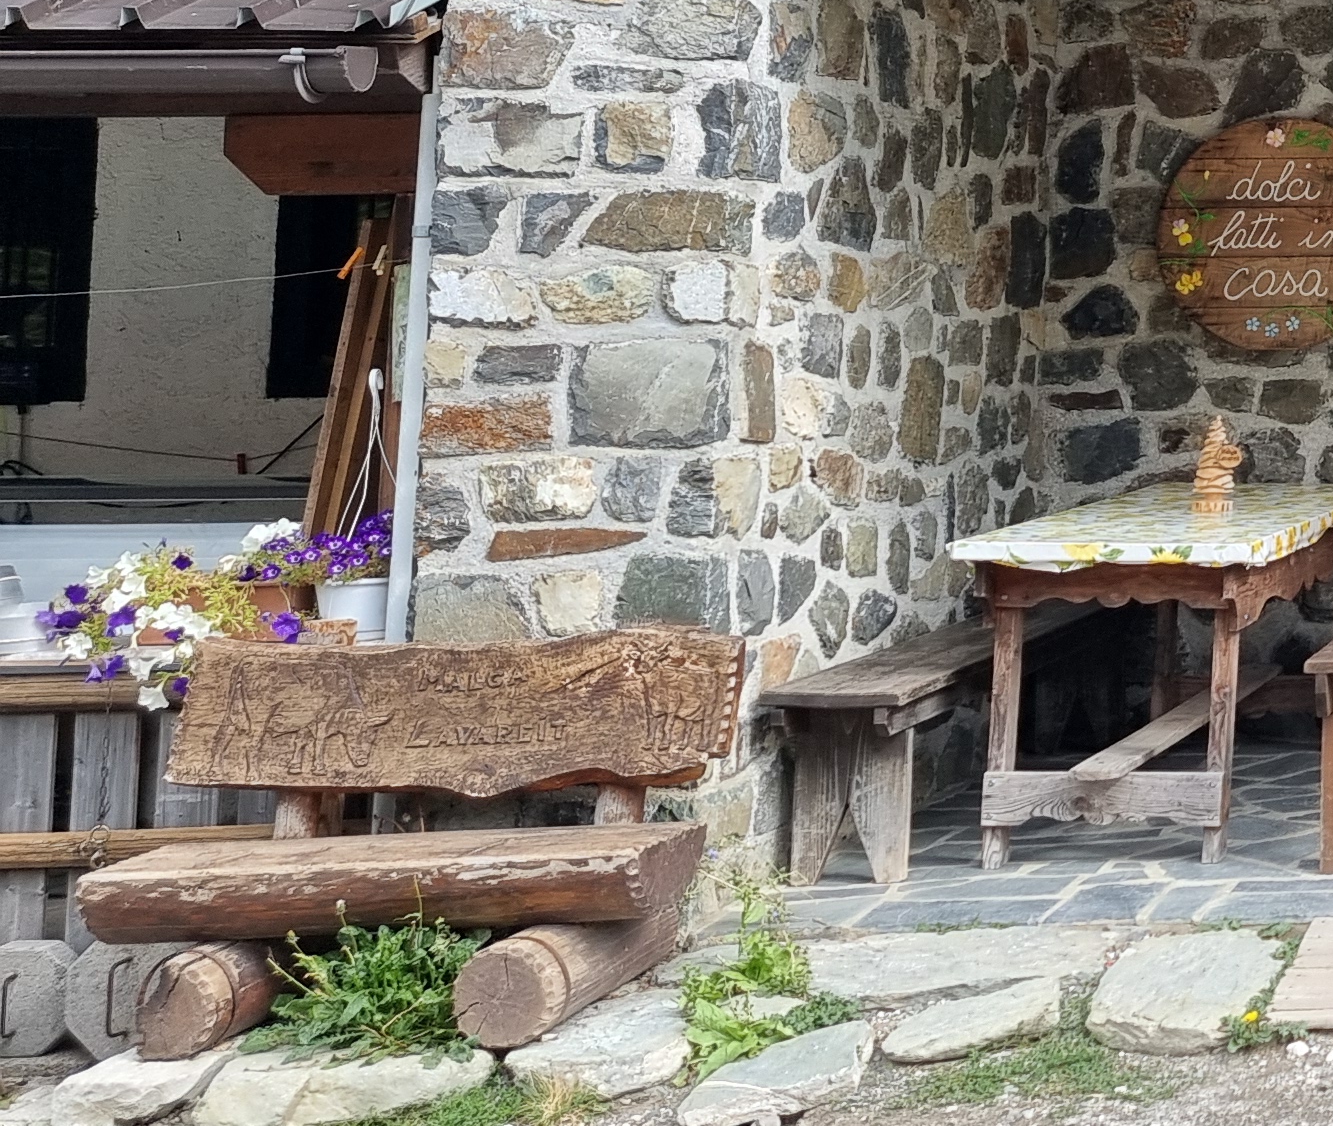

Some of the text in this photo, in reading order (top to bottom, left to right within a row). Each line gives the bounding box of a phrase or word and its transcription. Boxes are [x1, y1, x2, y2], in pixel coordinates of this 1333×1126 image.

[1226, 160, 1320, 202] dolci
[1207, 211, 1284, 256] fatti
[416, 667, 529, 693] MALGA
